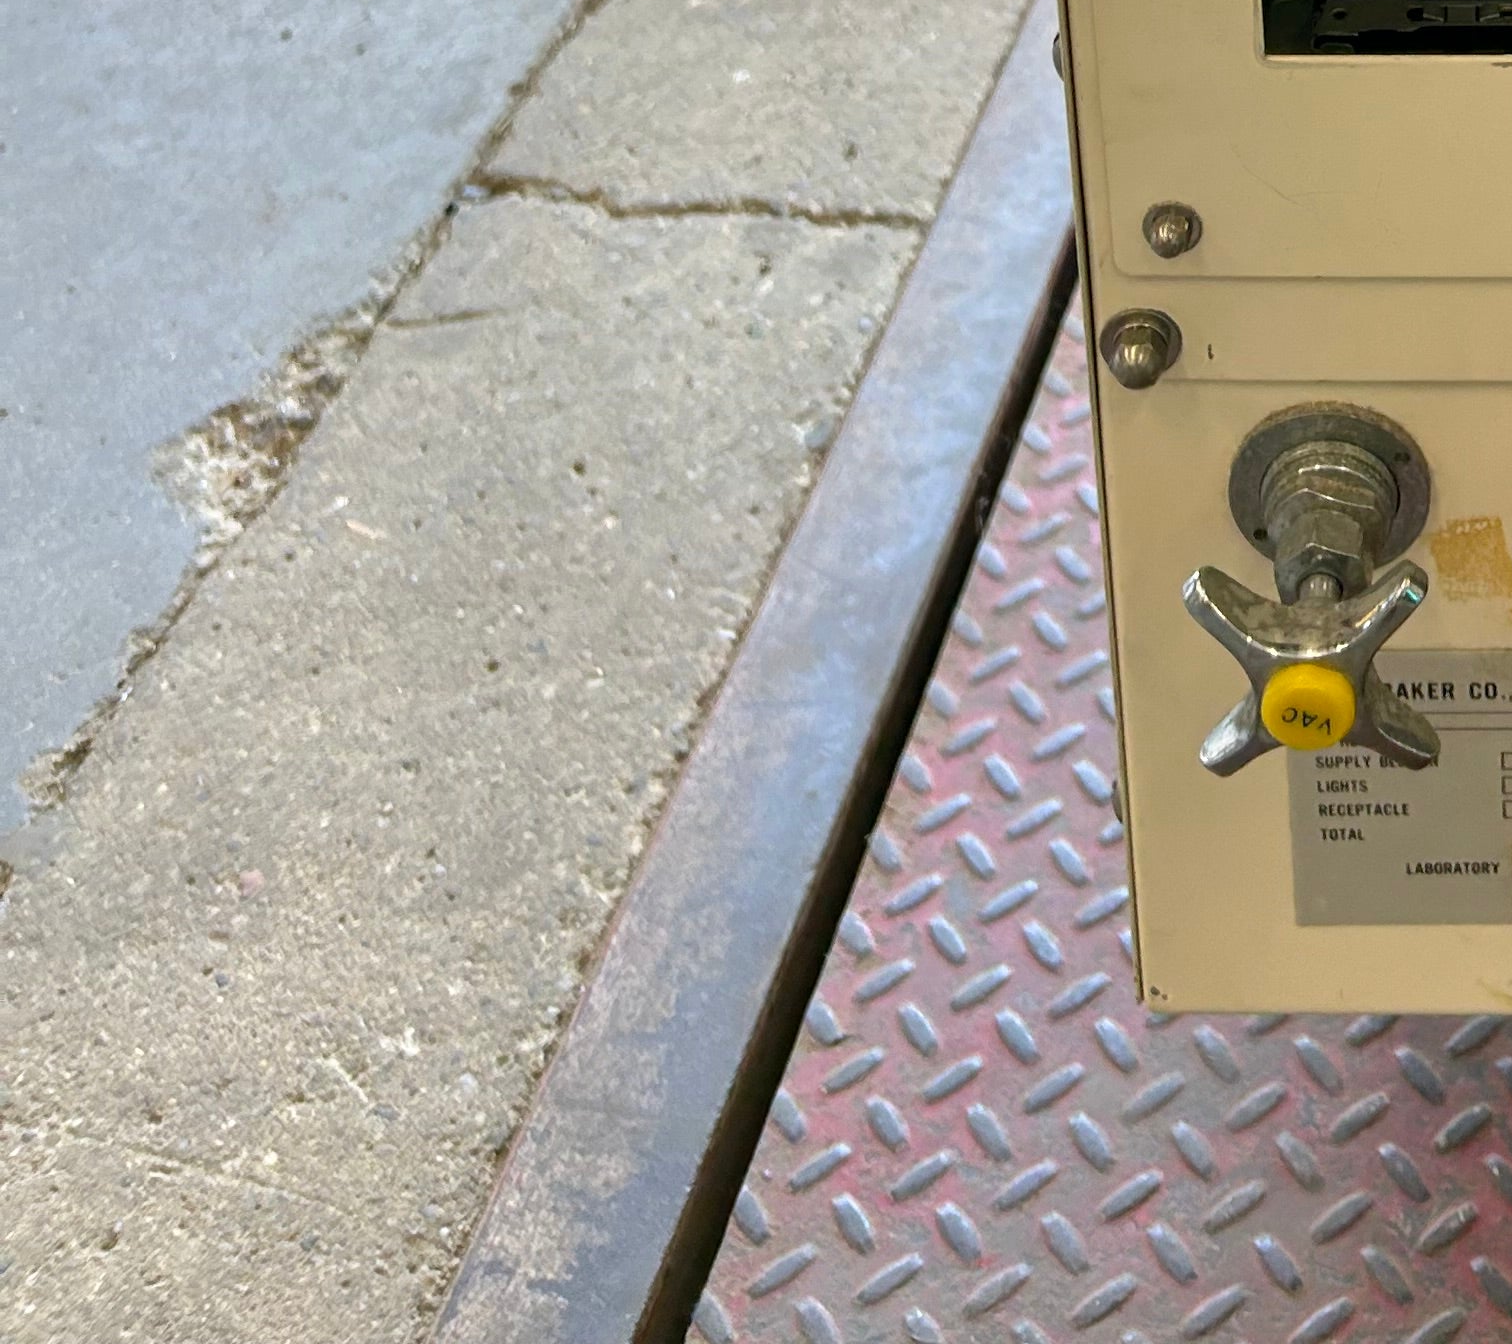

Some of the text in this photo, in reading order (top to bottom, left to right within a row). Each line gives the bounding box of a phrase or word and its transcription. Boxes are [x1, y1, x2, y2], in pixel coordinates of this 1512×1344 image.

[1281, 706, 1333, 737] VAC
[1314, 755, 1371, 770] SUPPLY
[1316, 779, 1369, 794] LIGHTS
[1318, 802, 1410, 818] RECEPTACLE
[1320, 827, 1365, 842] TOTAL
[1405, 860, 1501, 876] LABORATORY
